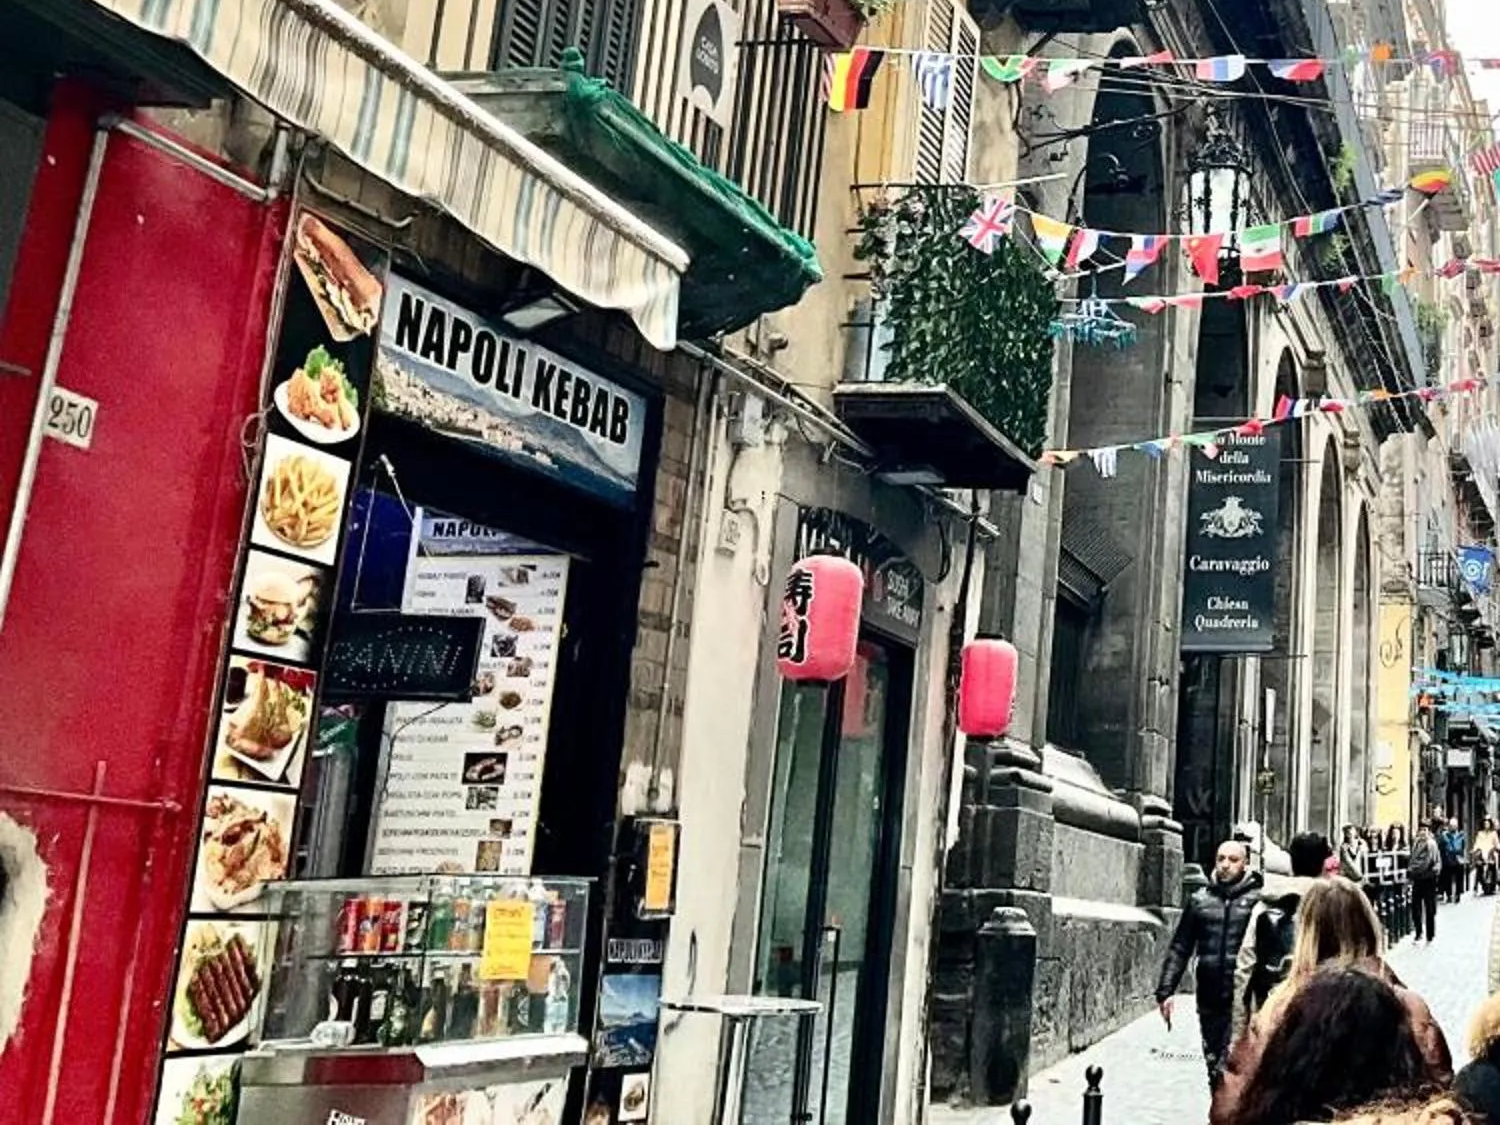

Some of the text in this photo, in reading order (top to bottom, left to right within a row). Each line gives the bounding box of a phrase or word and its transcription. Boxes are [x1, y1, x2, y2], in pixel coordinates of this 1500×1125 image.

[395, 292, 629, 444] NAPOLI KEBAB
[48, 395, 92, 438] 250
[1219, 450, 1249, 464] della
[1196, 469, 1271, 483] Misericordia
[1189, 555, 1270, 575] Caravaggio
[1195, 614, 1259, 632] Quadreria
